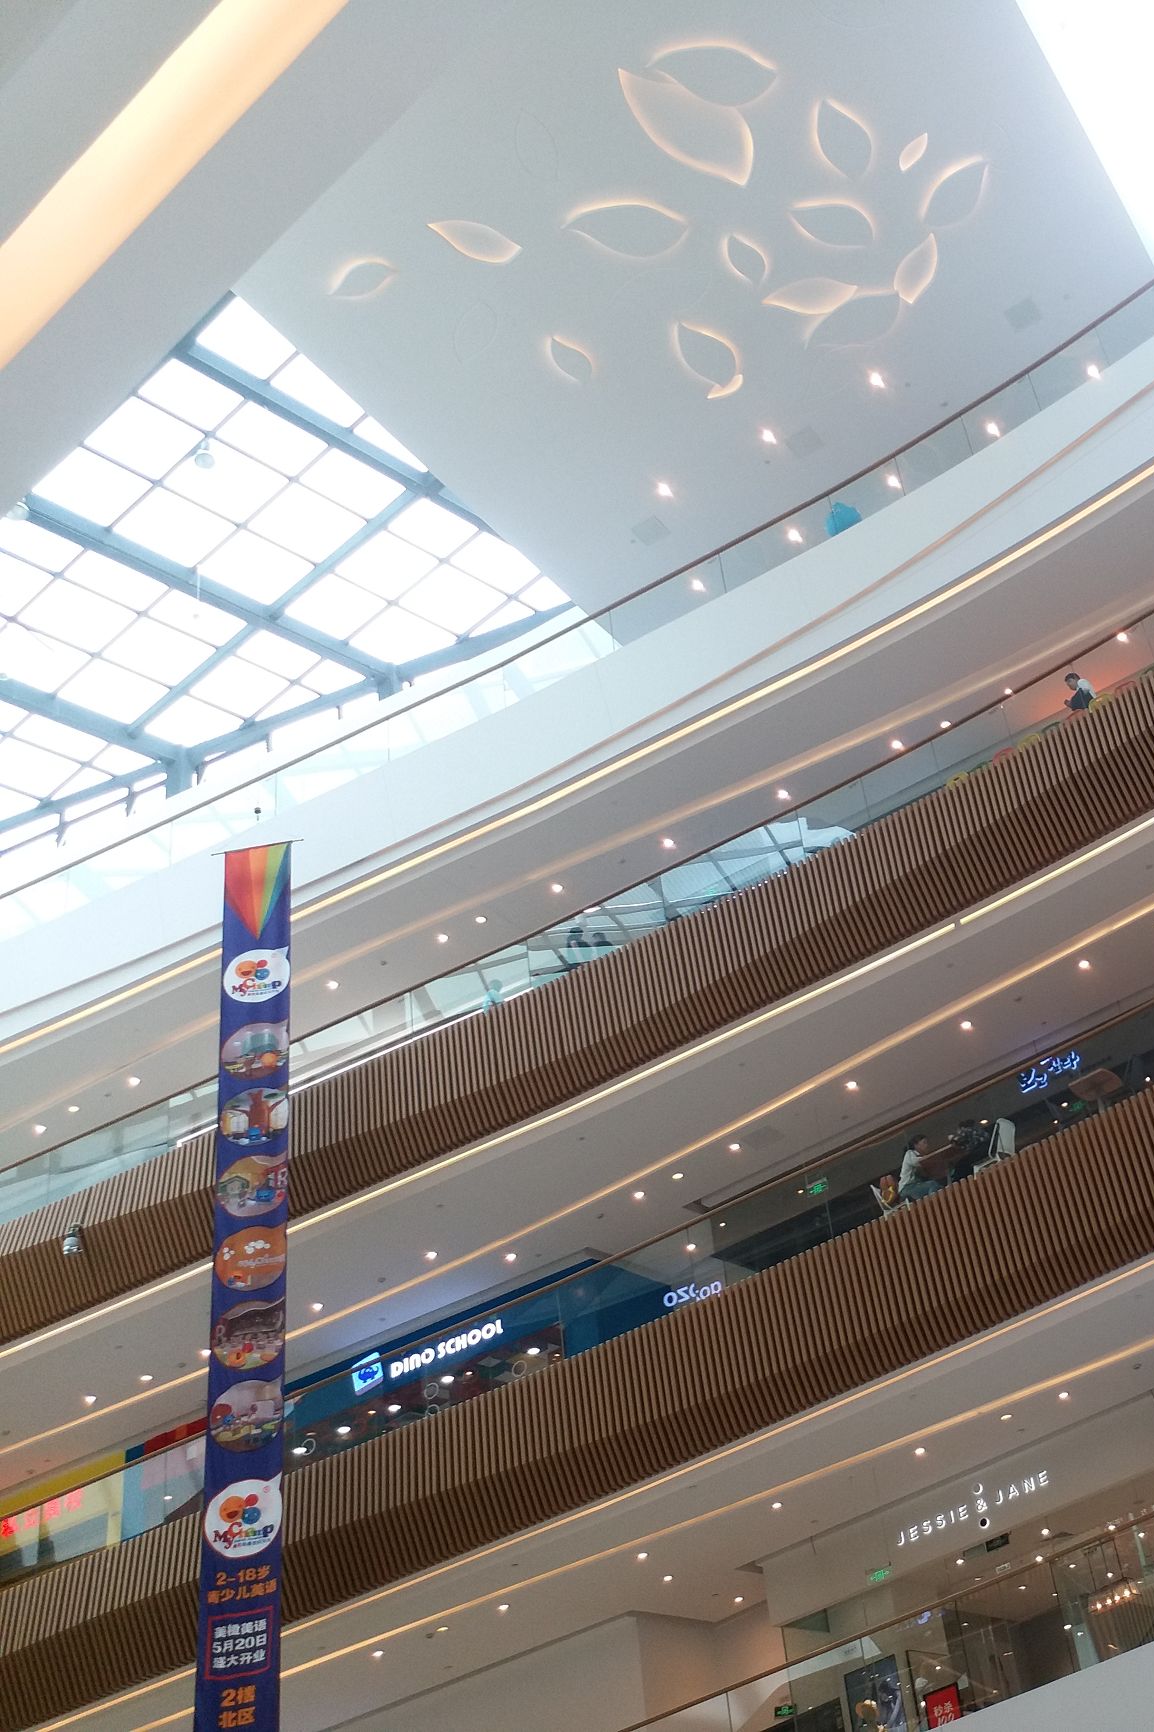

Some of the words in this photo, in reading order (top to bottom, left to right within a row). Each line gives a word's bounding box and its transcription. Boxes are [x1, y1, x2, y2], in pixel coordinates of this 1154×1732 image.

[390, 1347, 436, 1379] DINO
[437, 1319, 504, 1359] SCHOOL
[897, 1504, 969, 1546] JESSIE
[975, 1498, 988, 1513] &
[995, 1470, 1050, 1505] JANE
[211, 1648, 267, 1669] 盛大开业
[212, 1633, 268, 1654] 5月20日
